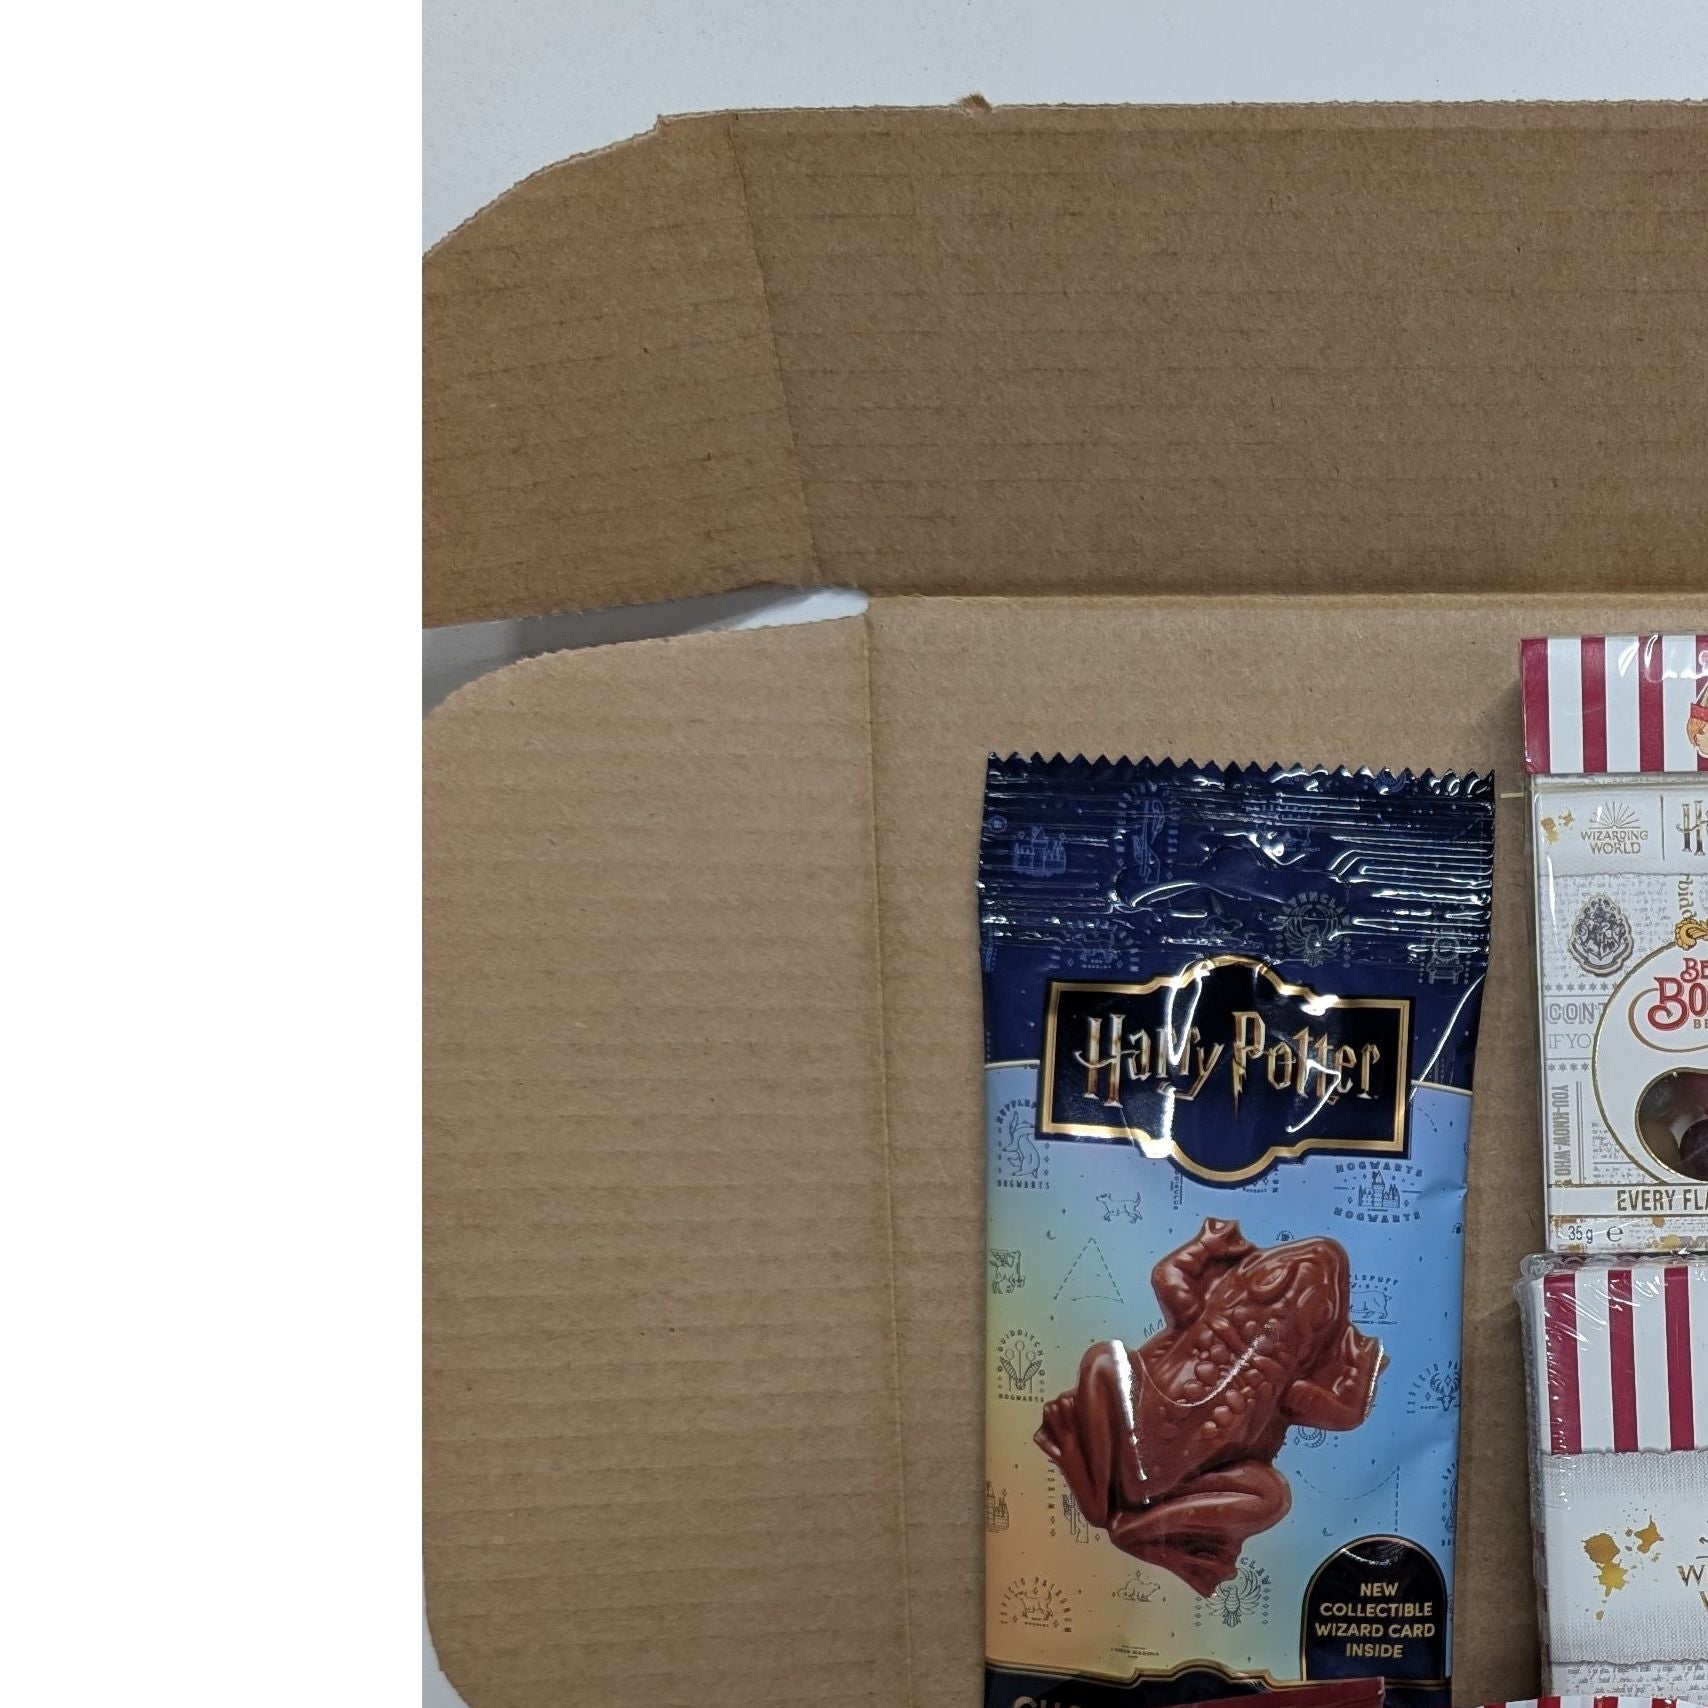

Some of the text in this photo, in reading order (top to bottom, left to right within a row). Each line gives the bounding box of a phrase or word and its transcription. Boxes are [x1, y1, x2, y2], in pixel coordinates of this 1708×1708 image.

[1581, 830, 1648, 842] WIZARDING
[1590, 842, 1641, 854] WORLD
[1075, 1011, 1381, 1120] Harry Potter
[1335, 1161, 1423, 1178] HOGWARTS
[1617, 1186, 1677, 1213] EVERY
[1333, 1207, 1421, 1223] HOGWARTS
[1360, 1582, 1399, 1597] NEW
[1320, 1602, 1433, 1618] COLLECTIBLE
[1315, 1623, 1436, 1639] WIZARD CARD
[1346, 1643, 1404, 1659] INSIDE
